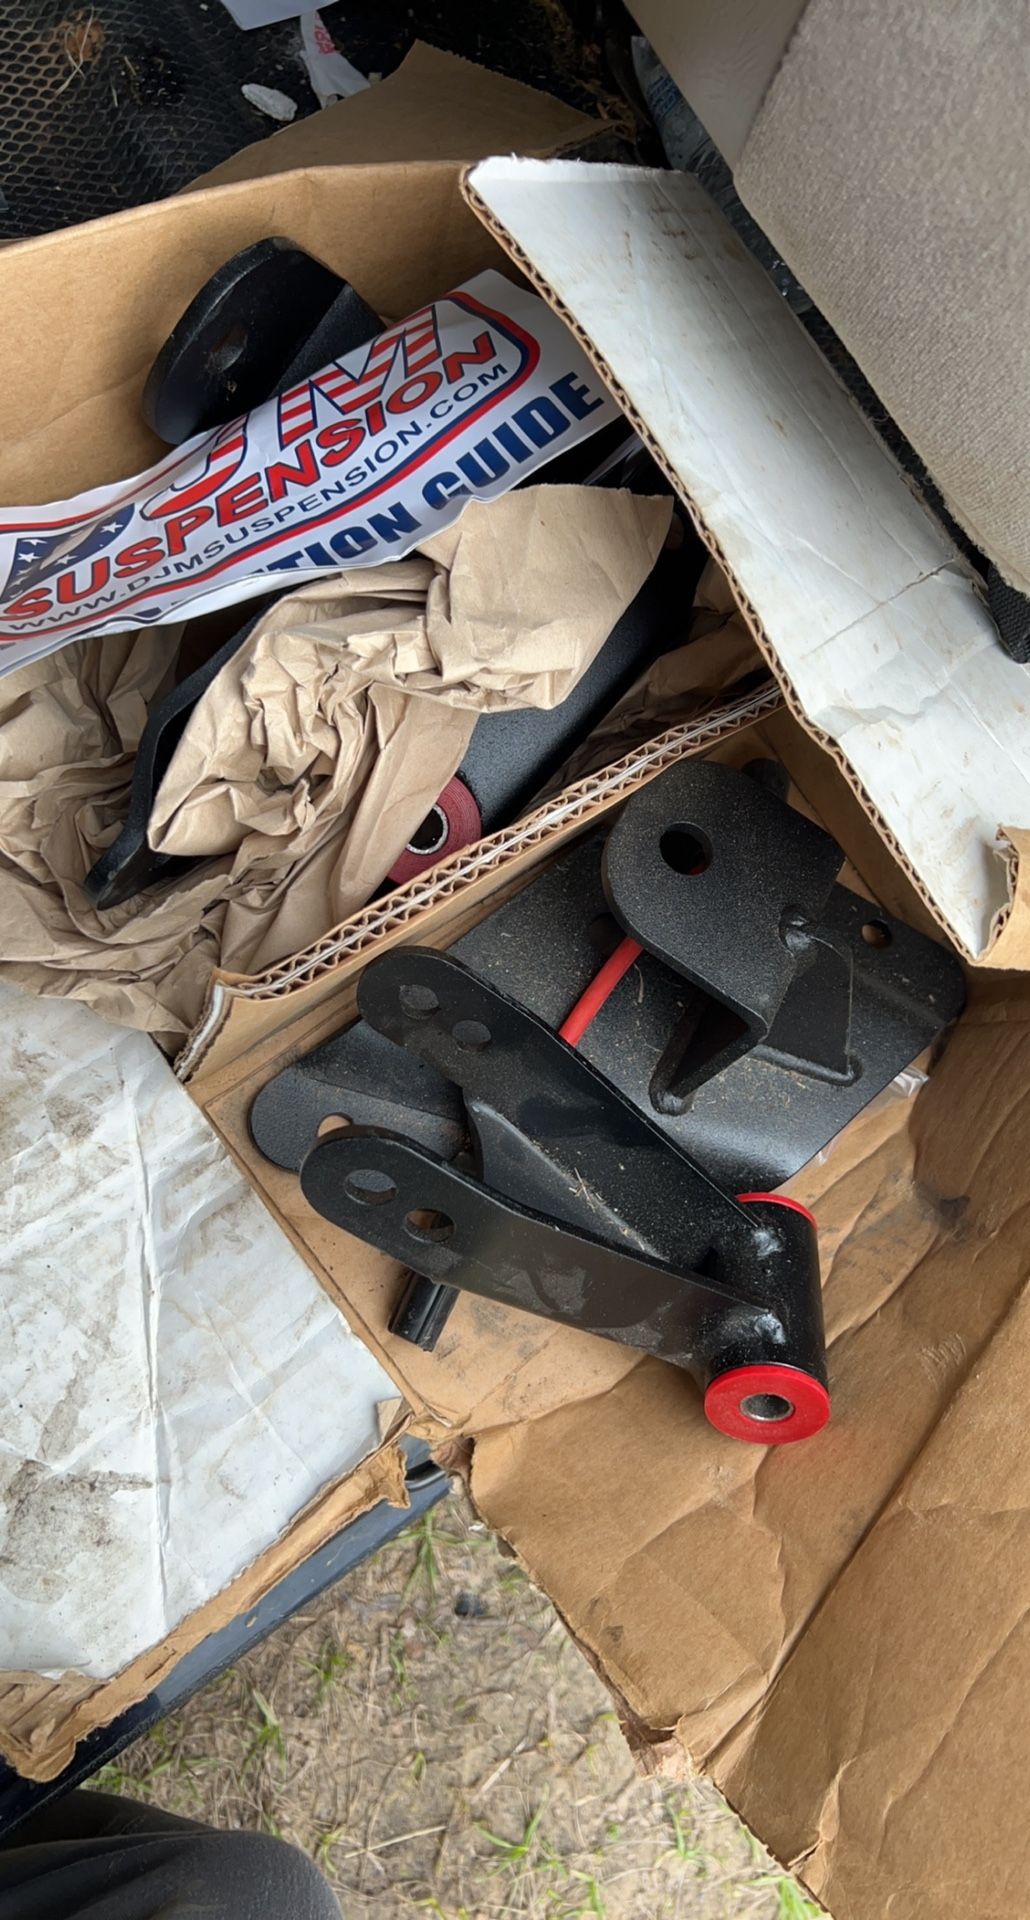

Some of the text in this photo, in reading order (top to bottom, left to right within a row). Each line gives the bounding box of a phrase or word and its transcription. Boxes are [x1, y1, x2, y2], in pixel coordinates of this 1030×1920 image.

[0, 330, 498, 621] SUSPENSION
[8, 363, 508, 630] WWW.DJMSUSPENSION.COM
[421, 371, 604, 510] GUIDE
